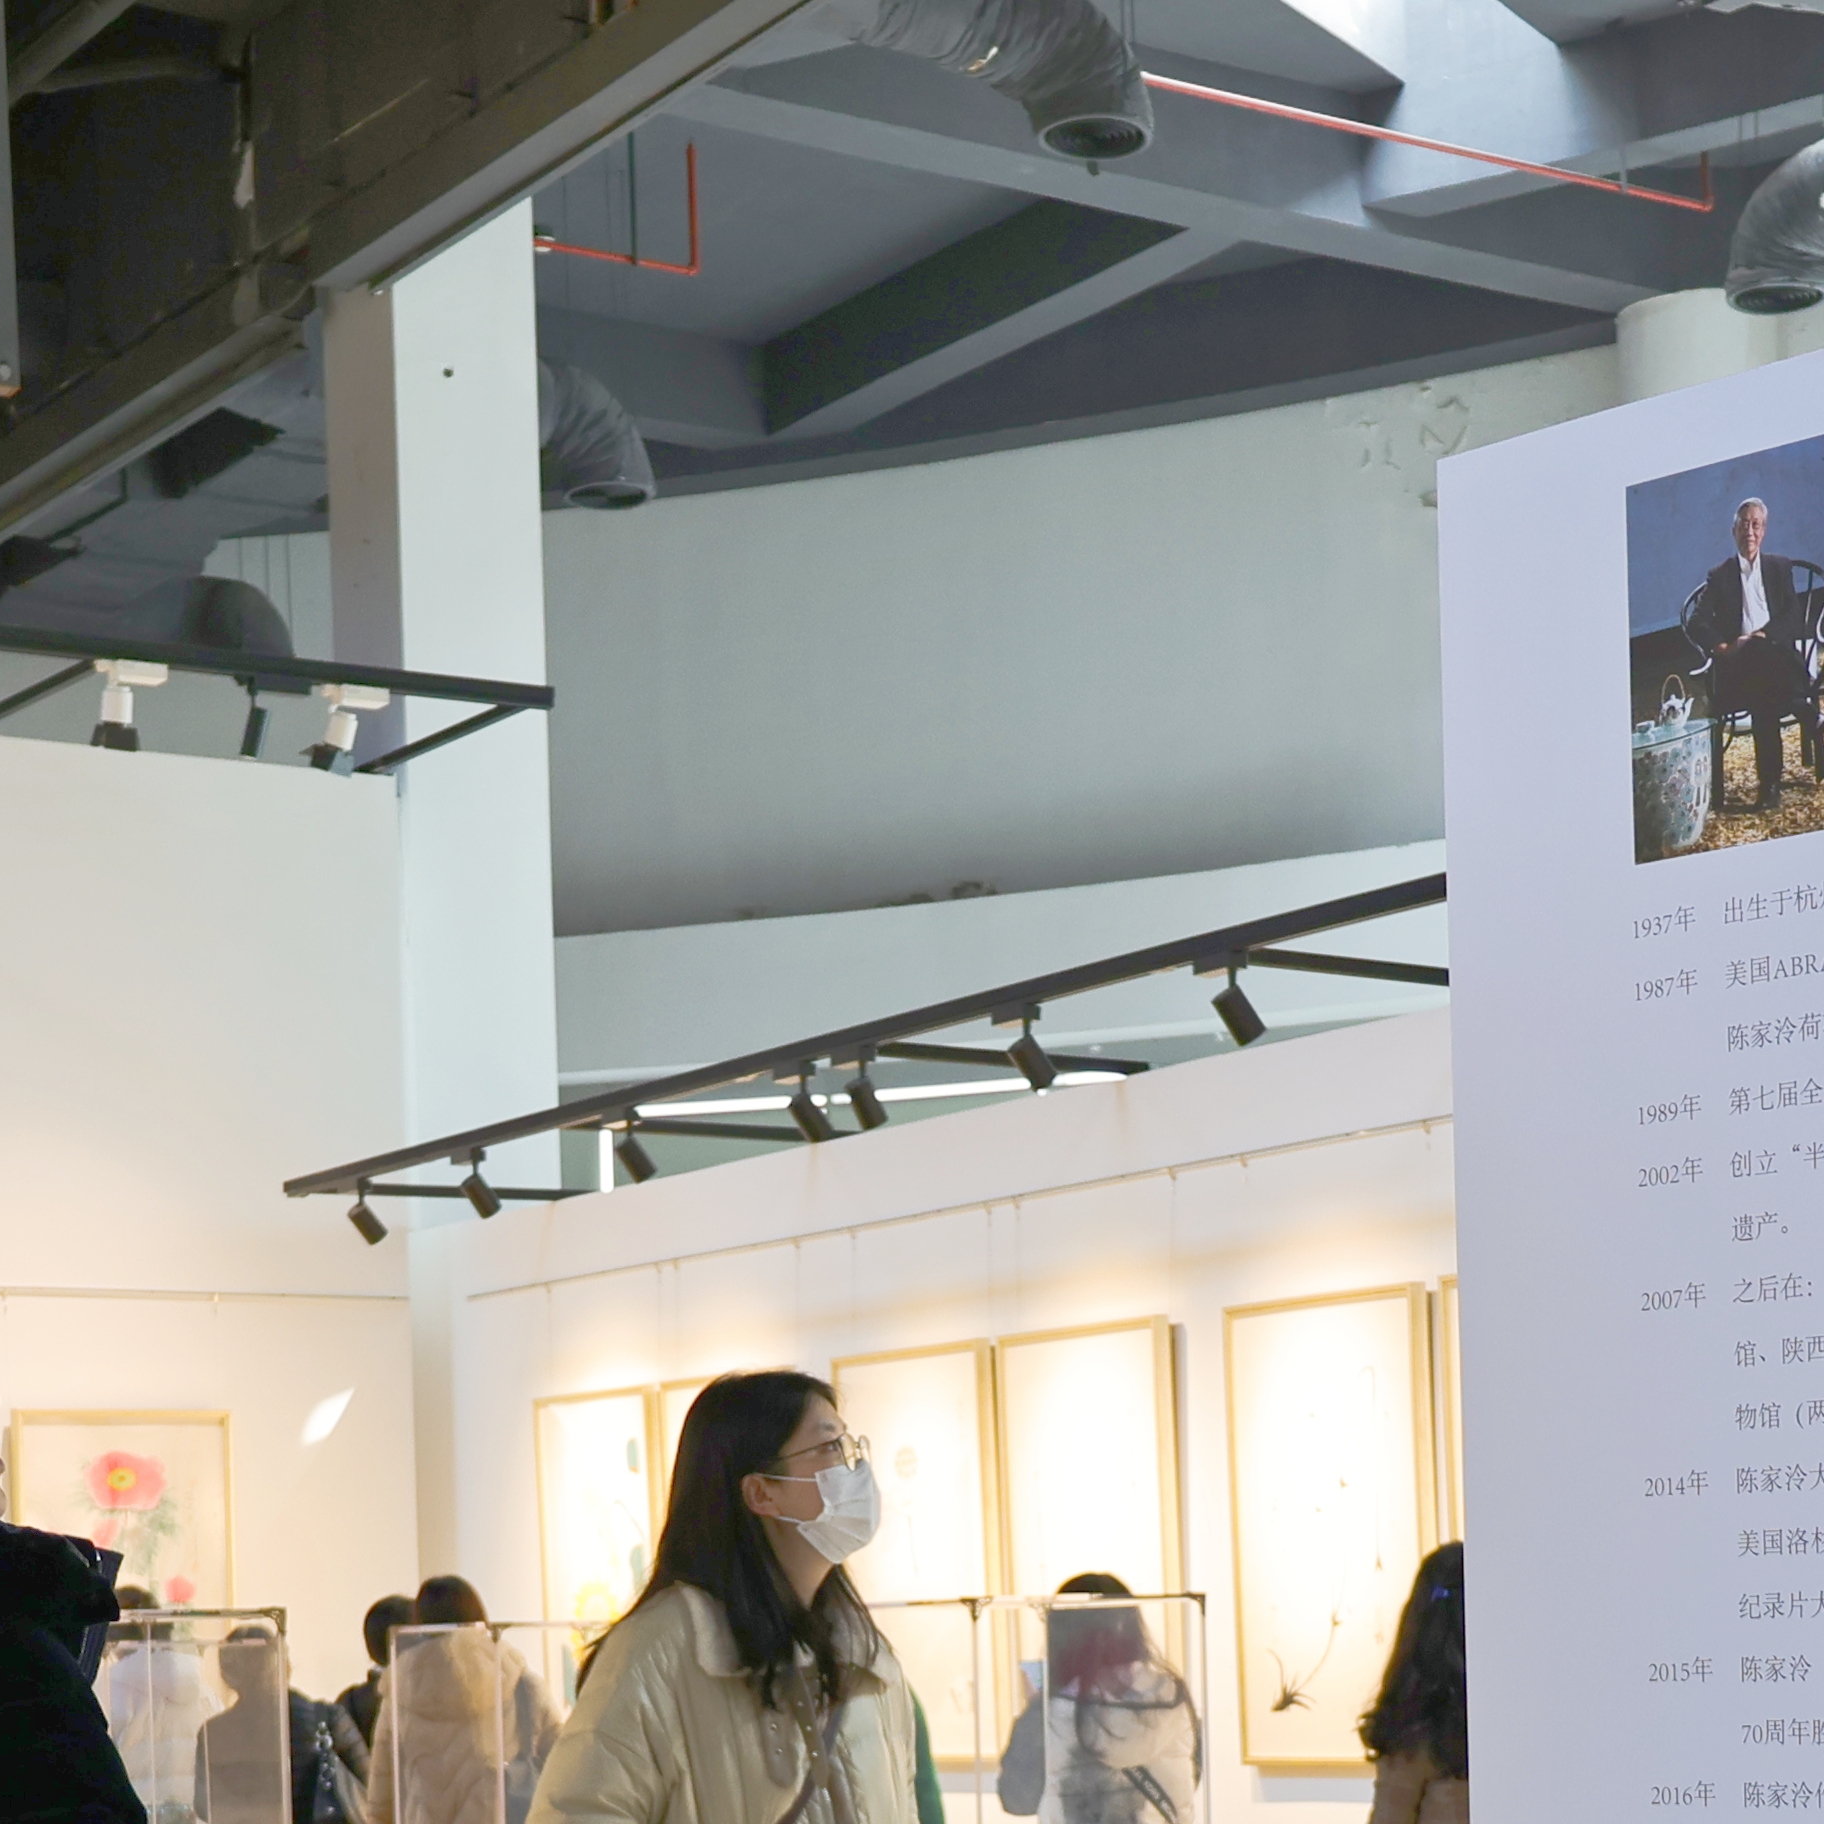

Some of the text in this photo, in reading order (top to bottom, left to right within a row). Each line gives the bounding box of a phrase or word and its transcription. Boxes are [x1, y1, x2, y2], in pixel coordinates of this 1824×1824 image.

[1633, 905, 1697, 940] 1937年
[1635, 968, 1699, 1002] 1987年
[1638, 1093, 1703, 1126] 1989年
[1637, 1156, 1704, 1188] 2002年
[1640, 1281, 1707, 1312] 2007年
[1644, 1468, 1709, 1498] 2014年
[1648, 1655, 1714, 1684] 2015年
[1650, 1779, 1717, 1808] 2016年
